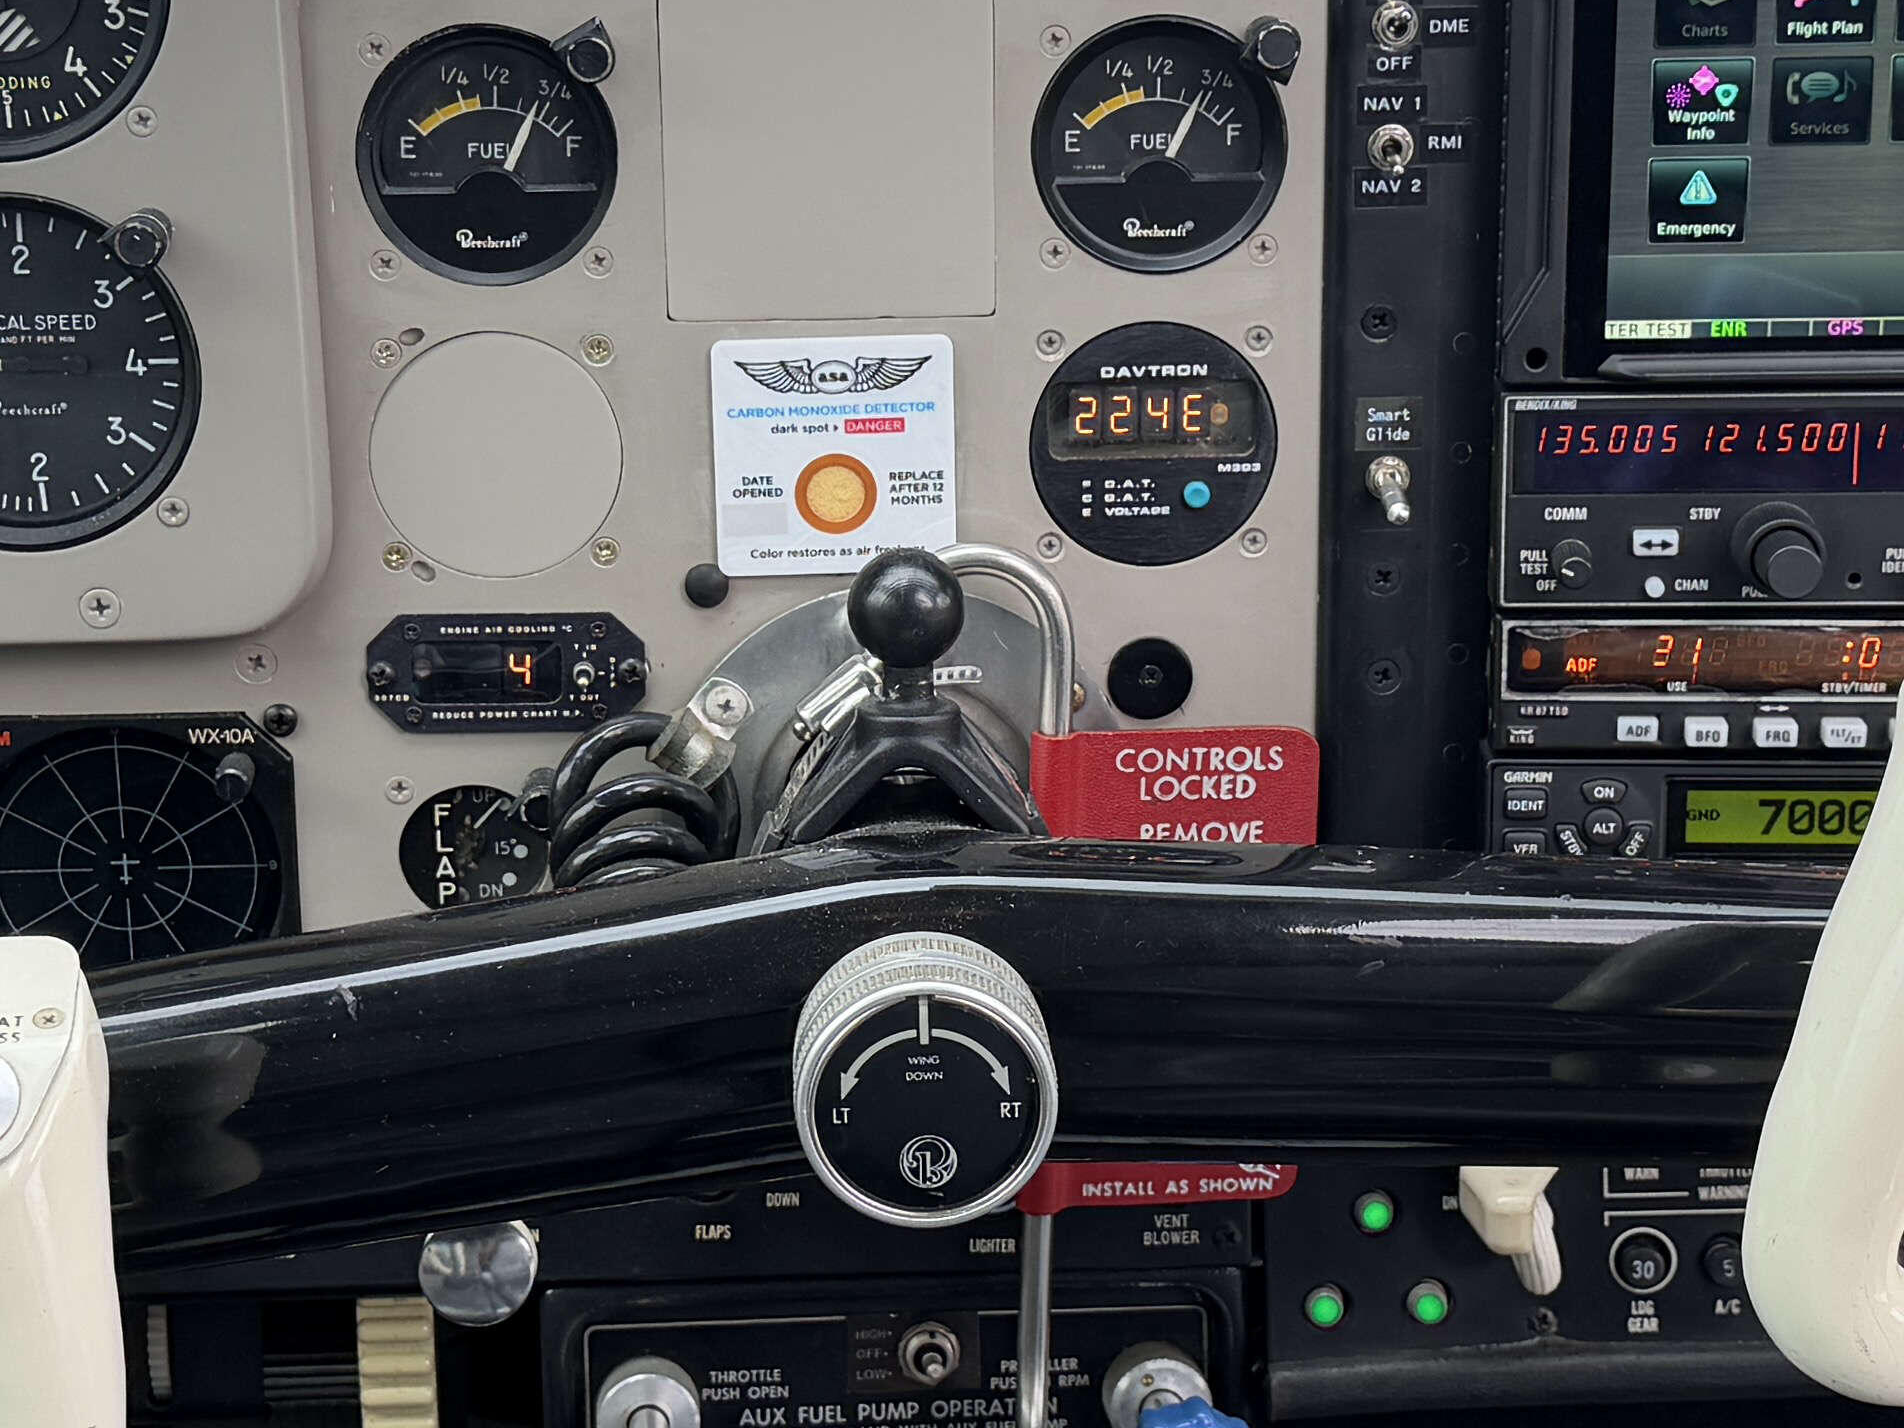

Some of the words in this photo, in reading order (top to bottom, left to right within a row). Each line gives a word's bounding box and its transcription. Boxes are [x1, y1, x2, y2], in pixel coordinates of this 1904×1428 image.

[1787, 19, 1830, 36] Flight
[1832, 19, 1864, 35] Plan
[1667, 109, 1736, 126] Waypoint
[1656, 221, 1736, 238] Emergency
[34, 313, 97, 331] SPEED
[1100, 363, 1208, 379] DAVTRON
[727, 406, 788, 420] CARBON
[790, 403, 864, 419] MONOXIDE
[868, 400, 936, 416] DETECTOR
[1074, 394, 1203, 435] 224E
[770, 422, 797, 434] dark
[801, 423, 829, 436] spot
[846, 419, 903, 432] DANGER
[1536, 422, 1678, 454] 135.005
[1702, 421, 1848, 452] 121.500
[741, 475, 774, 488] DATE
[888, 470, 945, 483] REPLACE
[732, 487, 783, 499] OPENED
[888, 483, 928, 495] AFTER
[932, 483, 944, 494] 12
[890, 494, 943, 507] MONTHS
[1544, 507, 1587, 521] COMM
[750, 548, 780, 559] Color
[783, 547, 833, 558] restores
[835, 548, 849, 558] as
[851, 546, 868, 557] air
[188, 727, 255, 744] WX-10A
[1115, 745, 1283, 774] CONTROLS
[1138, 772, 1257, 801] LOCKED
[1138, 820, 1264, 844] REMOVE
[1082, 1179, 1158, 1199] INSTALL
[1165, 1178, 1192, 1194] AS
[1199, 1176, 1273, 1194] SHOWN
[709, 1369, 782, 1384] THROTTLE
[739, 1407, 790, 1426] AUX
[798, 1404, 850, 1424] FUEL
[857, 1401, 921, 1421] PUMP
